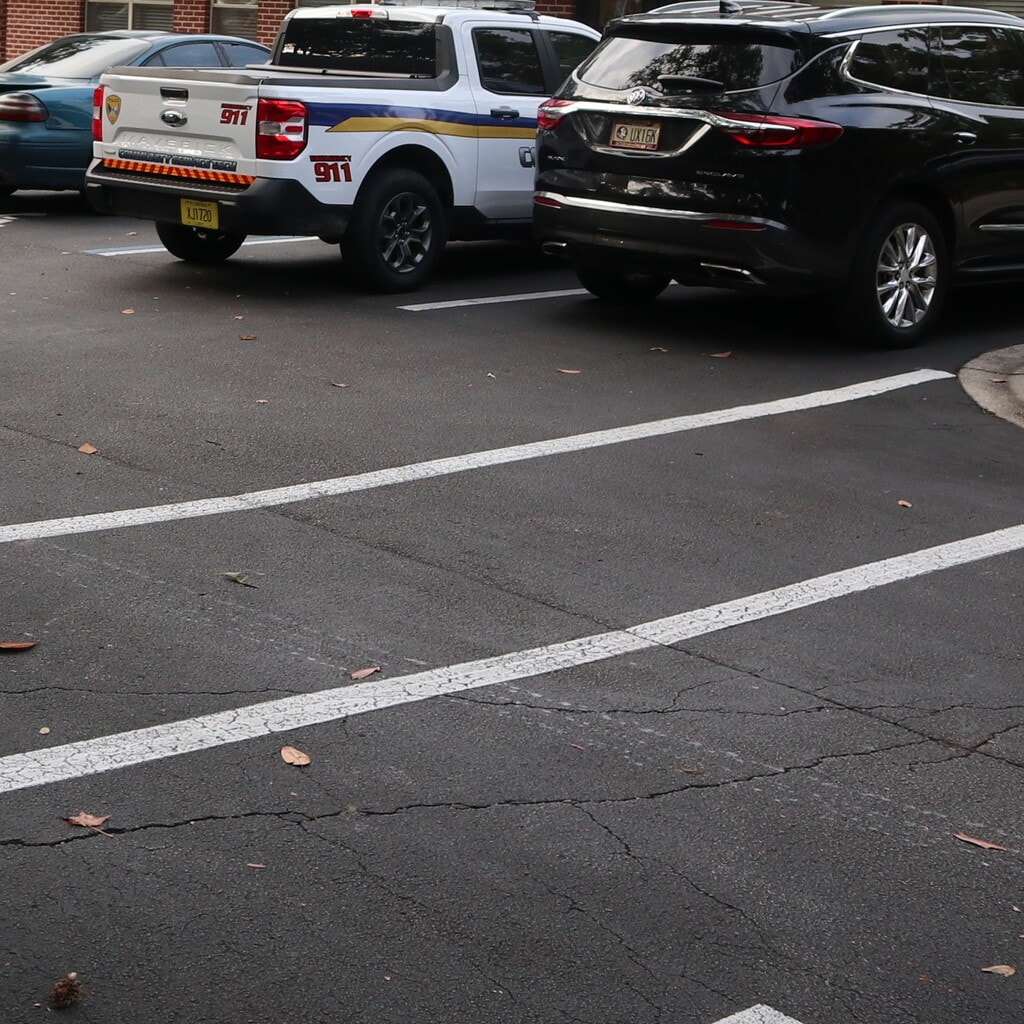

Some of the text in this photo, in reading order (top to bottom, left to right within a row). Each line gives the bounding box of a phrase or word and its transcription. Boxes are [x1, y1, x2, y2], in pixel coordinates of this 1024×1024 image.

[220, 109, 249, 125] 911
[118, 148, 238, 172] COMMUNITY SERVICE TECH
[314, 162, 352, 182] 911
